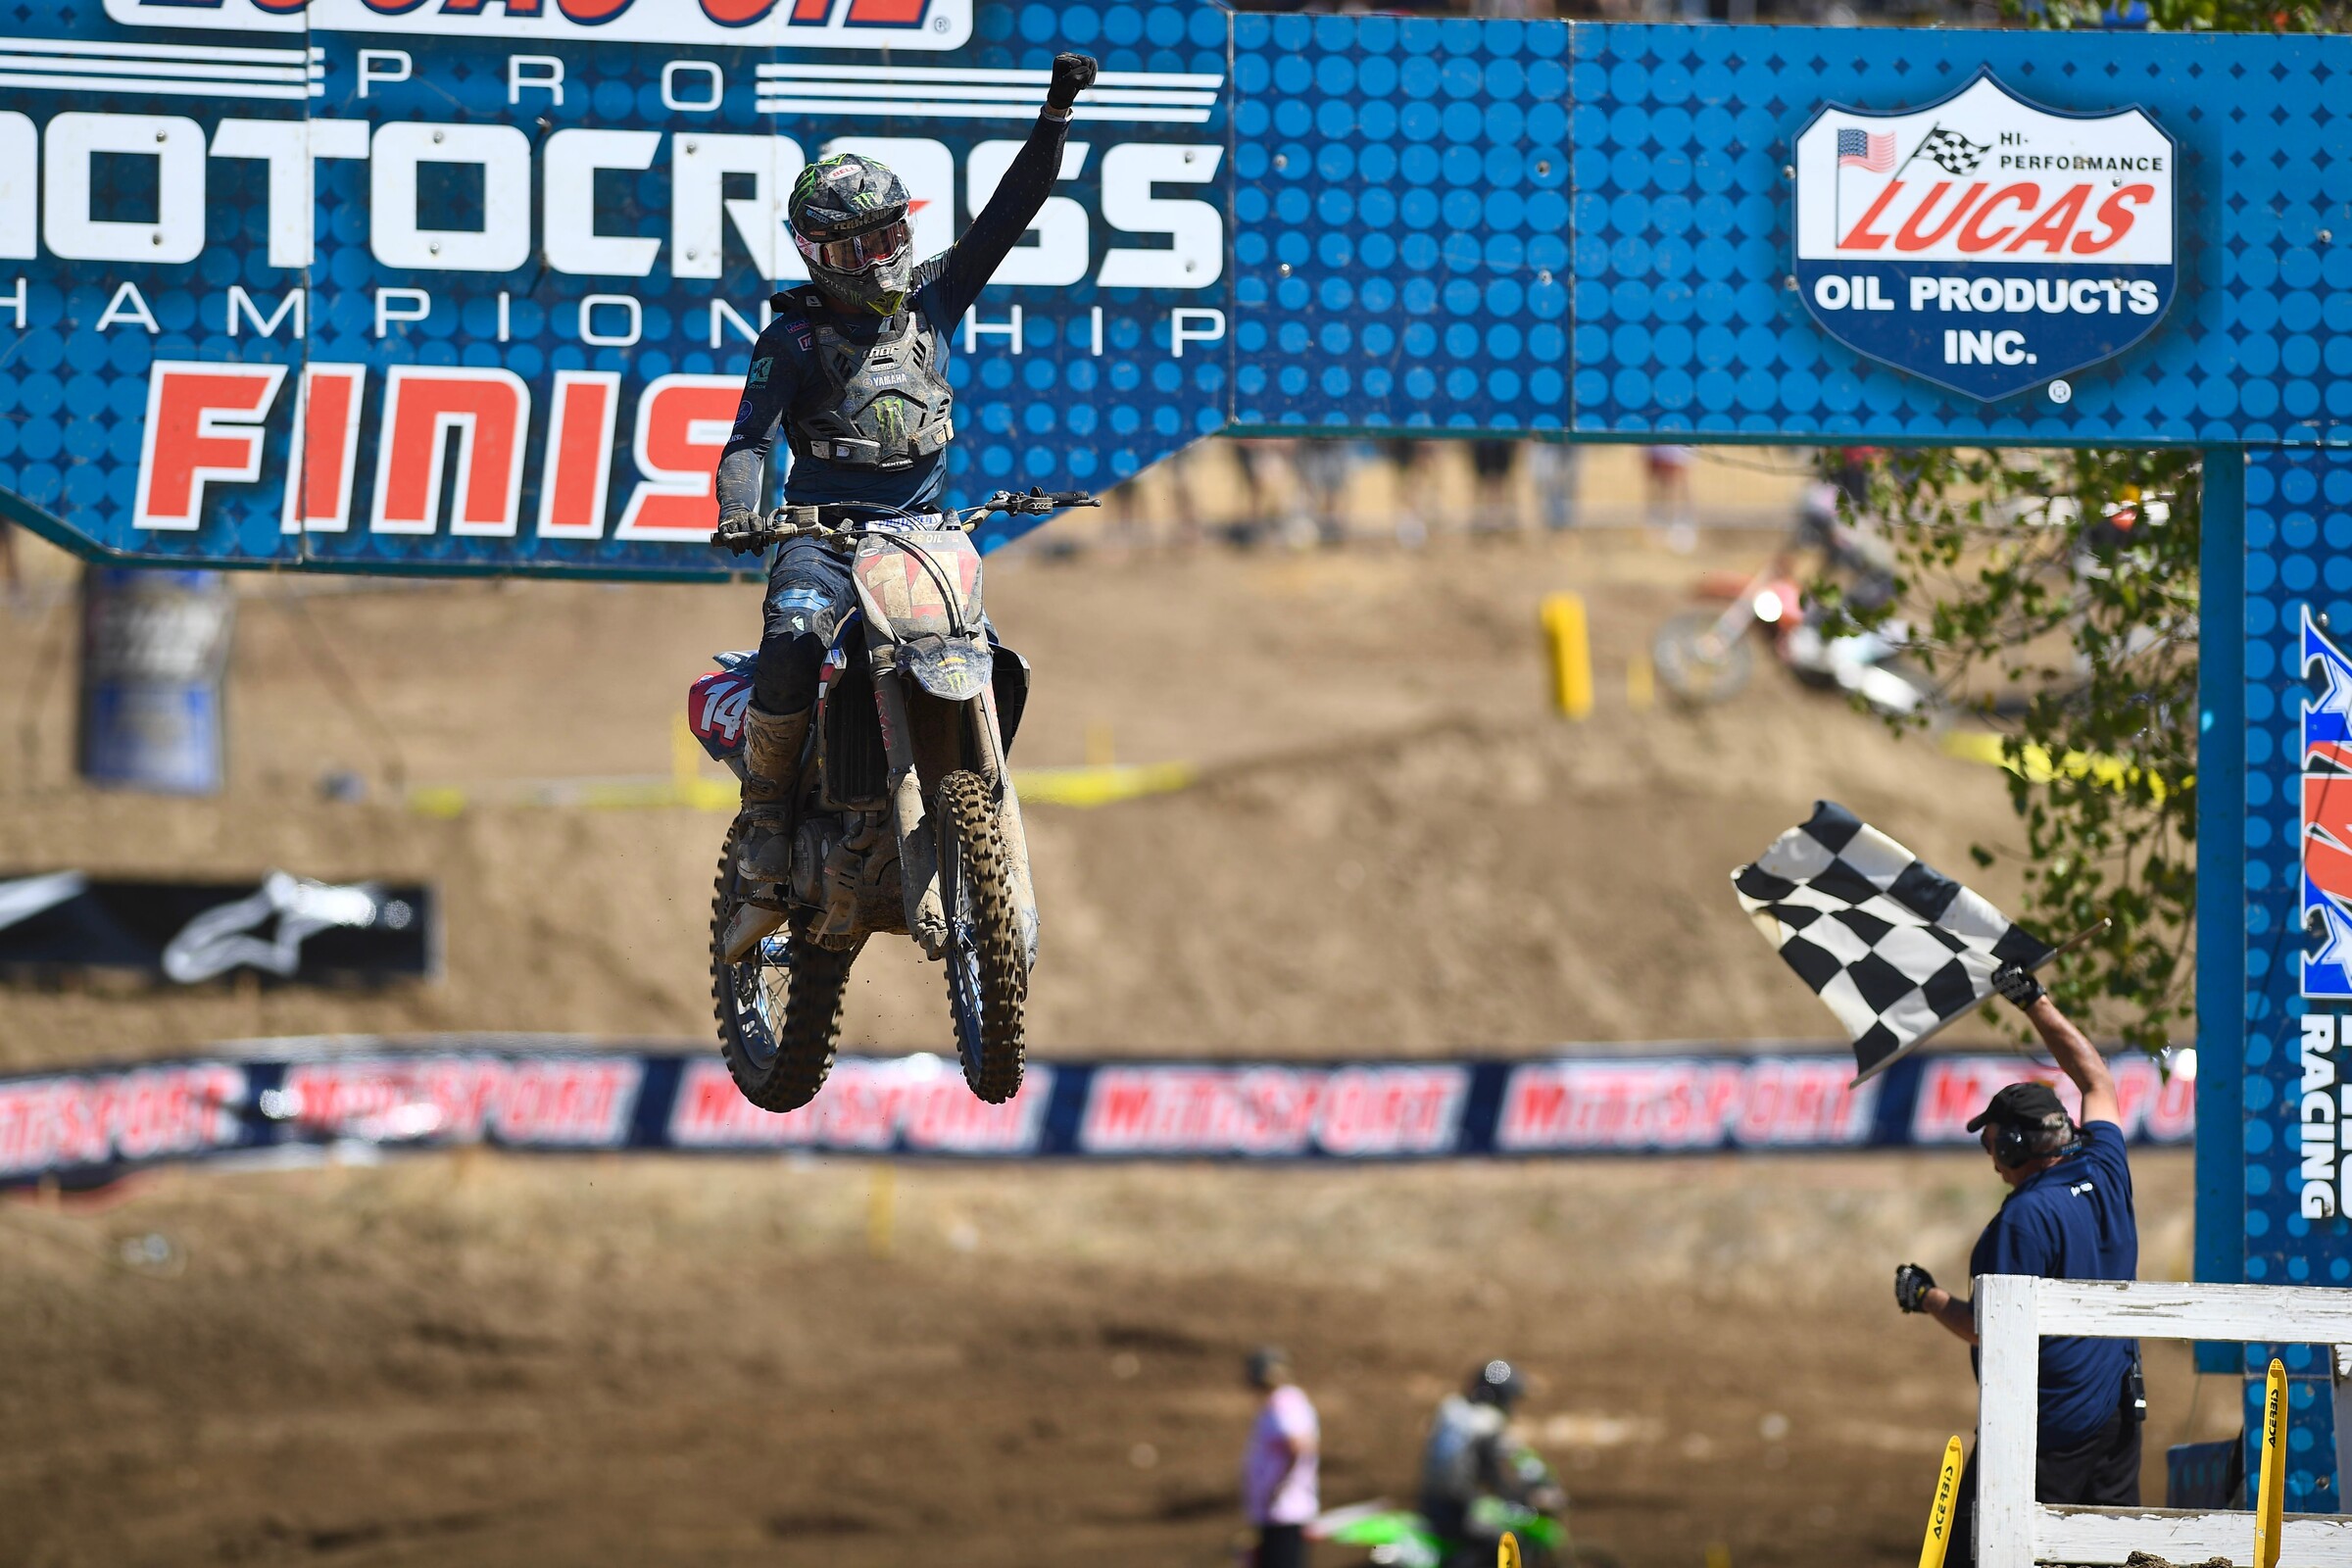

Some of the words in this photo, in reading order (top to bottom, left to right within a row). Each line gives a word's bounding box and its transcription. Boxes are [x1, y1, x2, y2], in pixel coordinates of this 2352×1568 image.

[357, 48, 725, 112] PRO
[1999, 131, 2030, 147] HI-
[1999, 155, 2164, 172] PERFORMANCE
[0, 109, 1225, 289] OTOCRSS
[1837, 180, 2156, 255] LUCAS
[0, 276, 1227, 359] AMPIONHIP
[1813, 275, 1895, 312] OIL
[1909, 275, 2160, 316] PRODUCTS
[873, 372, 907, 387] YAMAHA
[1943, 329, 2038, 367] INC.
[132, 359, 796, 542] FINIS
[700, 679, 756, 742] 14
[2300, 1013, 2335, 1220] RACING
